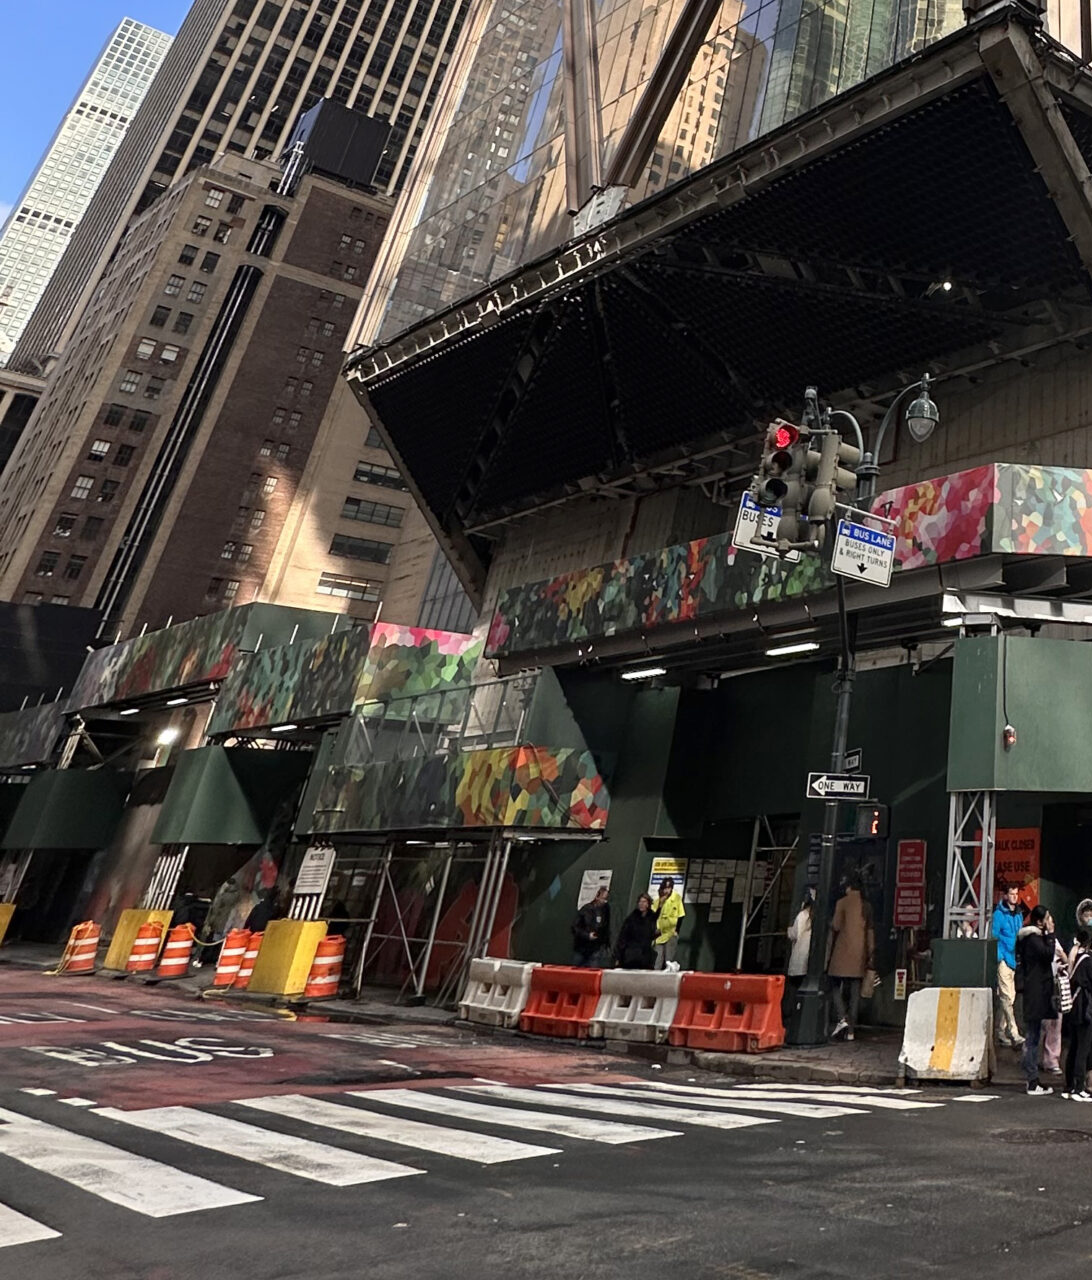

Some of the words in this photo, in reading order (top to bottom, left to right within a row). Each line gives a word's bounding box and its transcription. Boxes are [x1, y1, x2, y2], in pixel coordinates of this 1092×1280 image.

[742, 509, 773, 527] BUSES
[854, 529, 869, 540] BUS
[870, 534, 892, 547] LANE
[845, 540, 866, 552] BUSES
[868, 546, 886, 558] ONLY
[838, 548, 845, 556] &
[845, 550, 865, 562] RIGHT
[866, 555, 888, 569] TURNS
[817, 781, 835, 791] ONE
[843, 781, 862, 792] WAY
[20, 1037, 275, 1067] BUS
